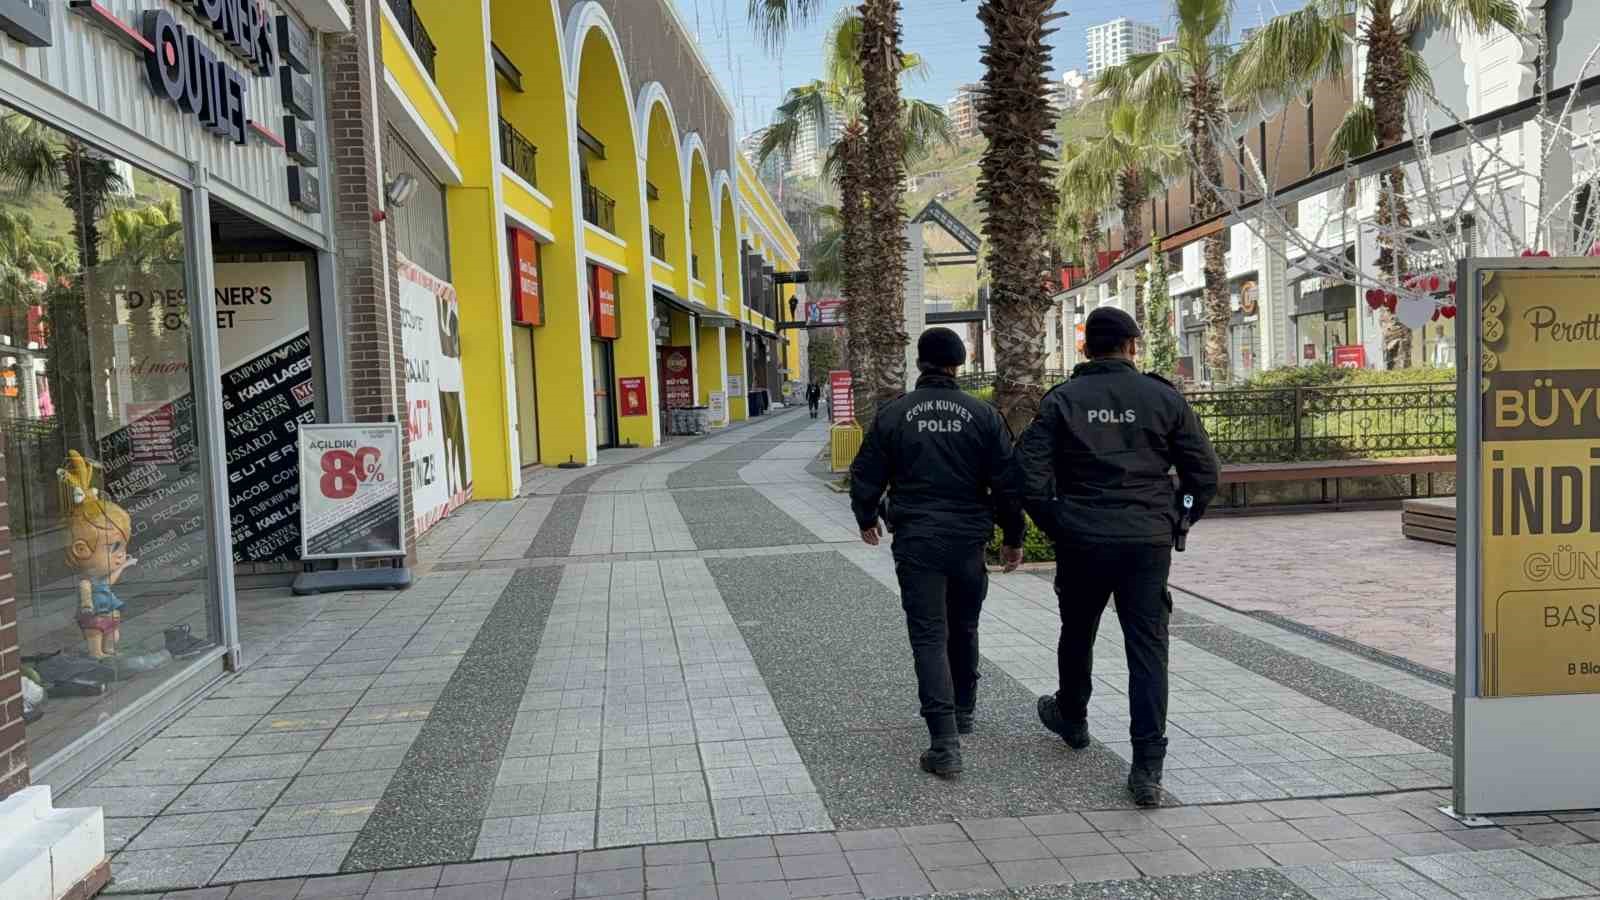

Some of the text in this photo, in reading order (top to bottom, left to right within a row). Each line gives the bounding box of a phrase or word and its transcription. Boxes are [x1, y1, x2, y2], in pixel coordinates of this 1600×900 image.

[144, 10, 247, 145] OUTLET
[238, 378, 276, 402] KARL
[1495, 378, 1600, 428] BÜY
[227, 394, 287, 429] ALEXANDER
[935, 400, 973, 422] KUVVET
[229, 480, 271, 509] JACOB
[1568, 662, 1577, 676] B
